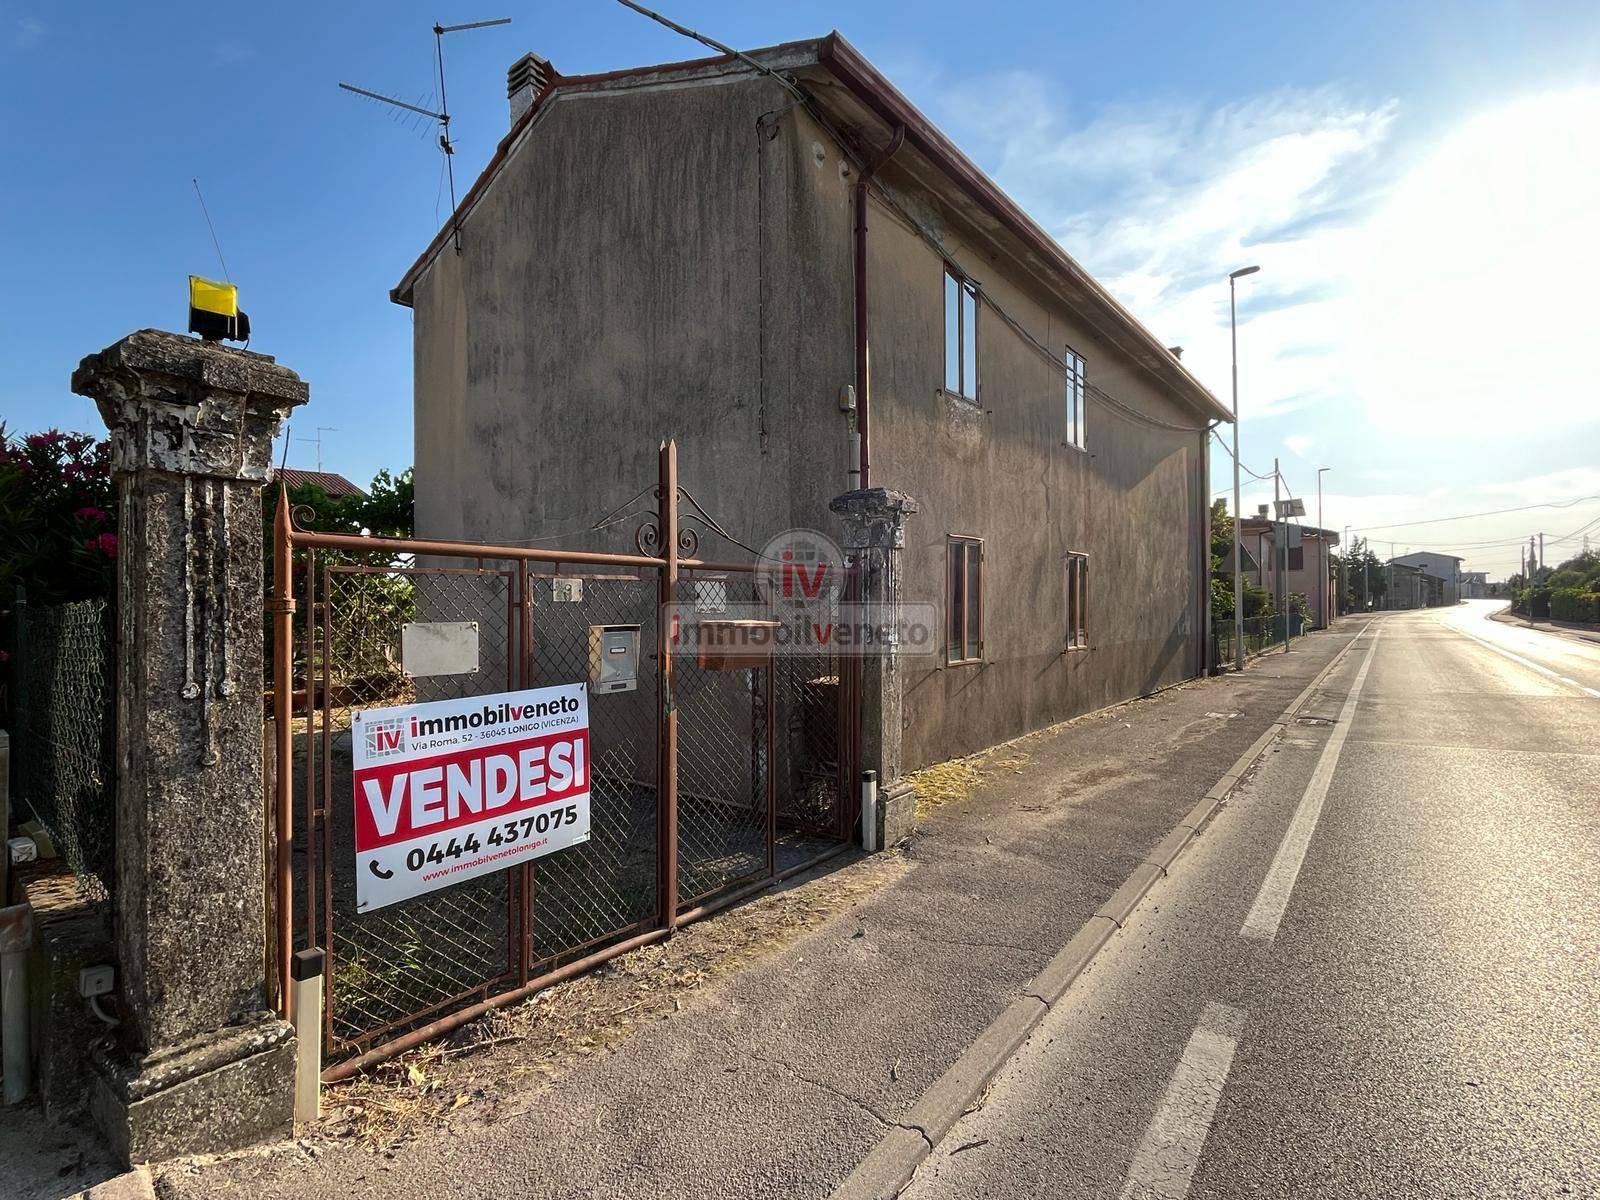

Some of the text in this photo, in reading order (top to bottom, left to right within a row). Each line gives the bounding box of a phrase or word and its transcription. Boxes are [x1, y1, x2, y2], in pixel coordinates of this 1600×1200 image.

[375, 724, 402, 752] iv
[411, 695, 580, 738] immobilveneto
[411, 739, 428, 752] Via
[430, 735, 460, 749] Roma,
[462, 734, 473, 743] 52
[480, 727, 507, 740] 36045
[508, 722, 540, 735] LONIGO
[541, 715, 579, 731] (VICENZA)
[361, 738, 585, 837] VENDESI
[406, 804, 578, 872] 0444 437075
[422, 837, 548, 882] www.immobilvenetolonigo.it
